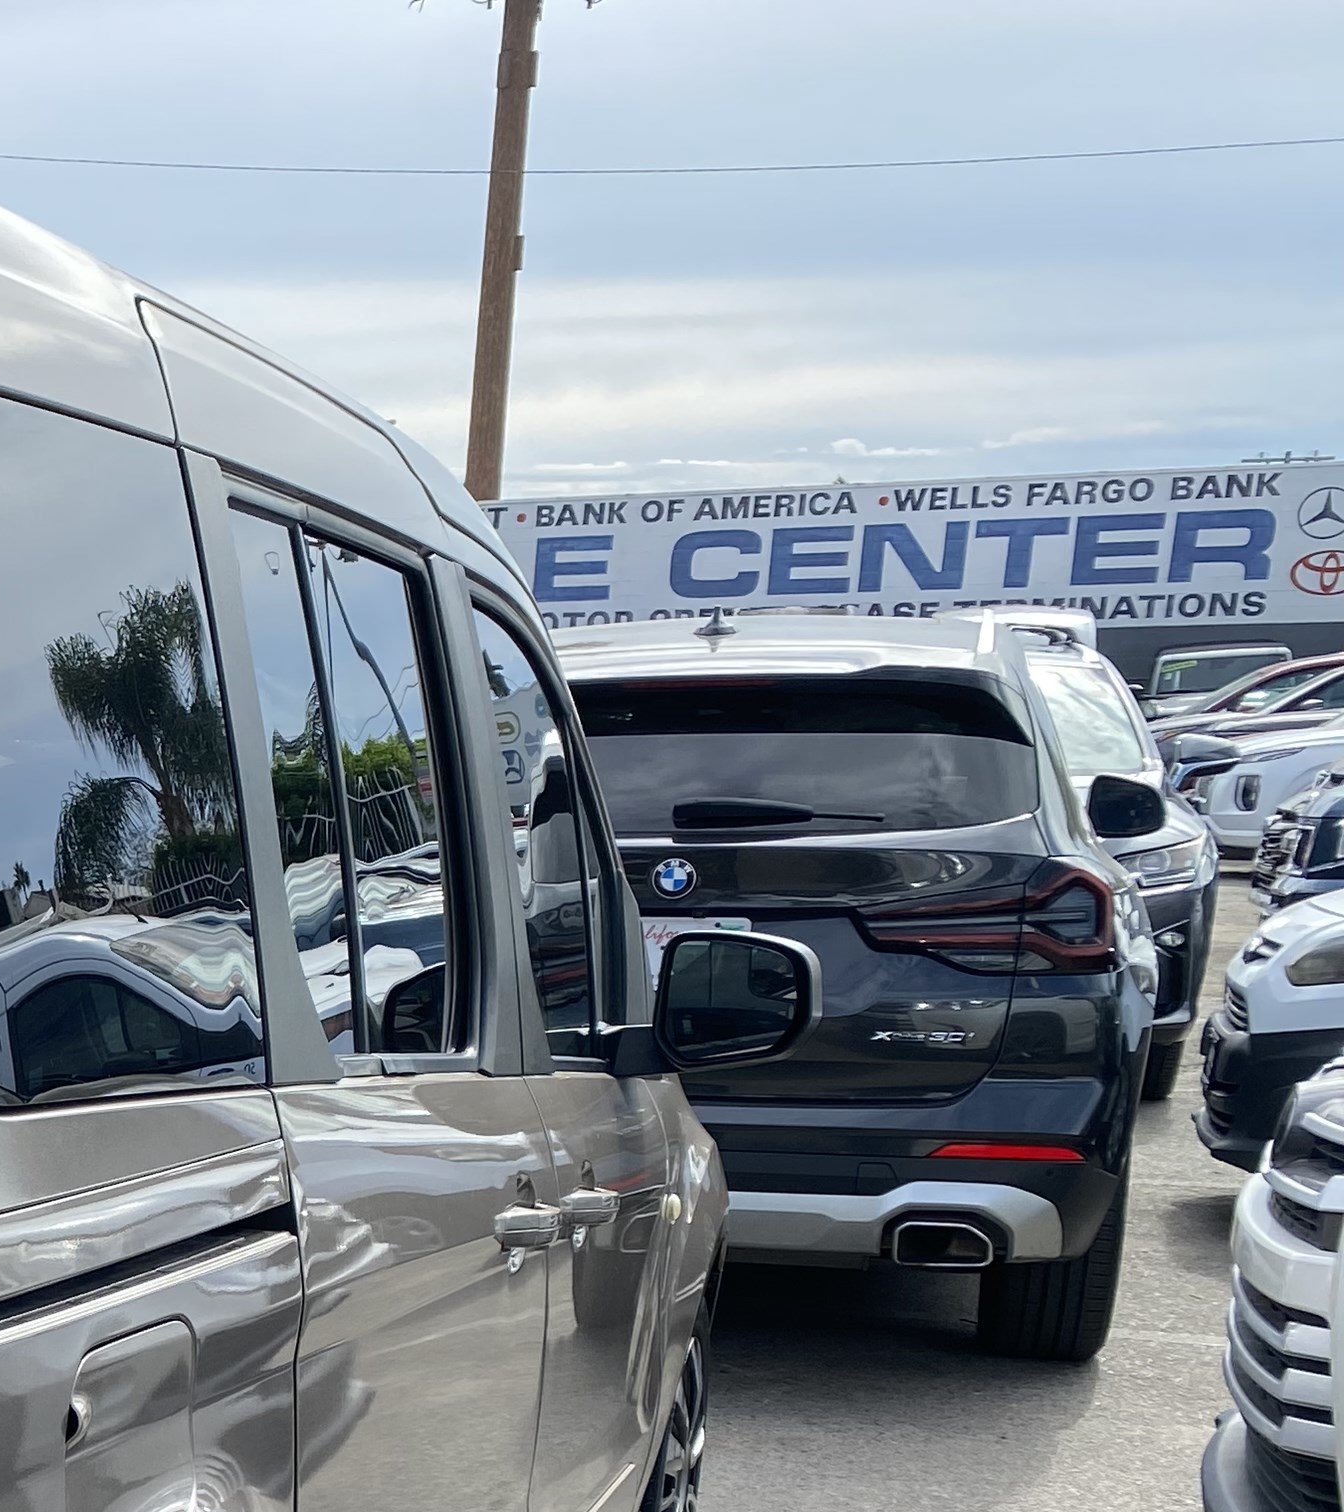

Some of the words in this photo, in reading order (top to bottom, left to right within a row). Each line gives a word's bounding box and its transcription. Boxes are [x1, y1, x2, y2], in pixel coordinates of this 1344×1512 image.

[535, 502, 627, 528] BANK
[641, 499, 686, 523] OF
[693, 491, 857, 521] AMERICA
[893, 484, 1013, 512] WELLS
[1026, 477, 1155, 506] FARGO
[1169, 472, 1283, 500] BANK
[669, 508, 1277, 598] CENTER
